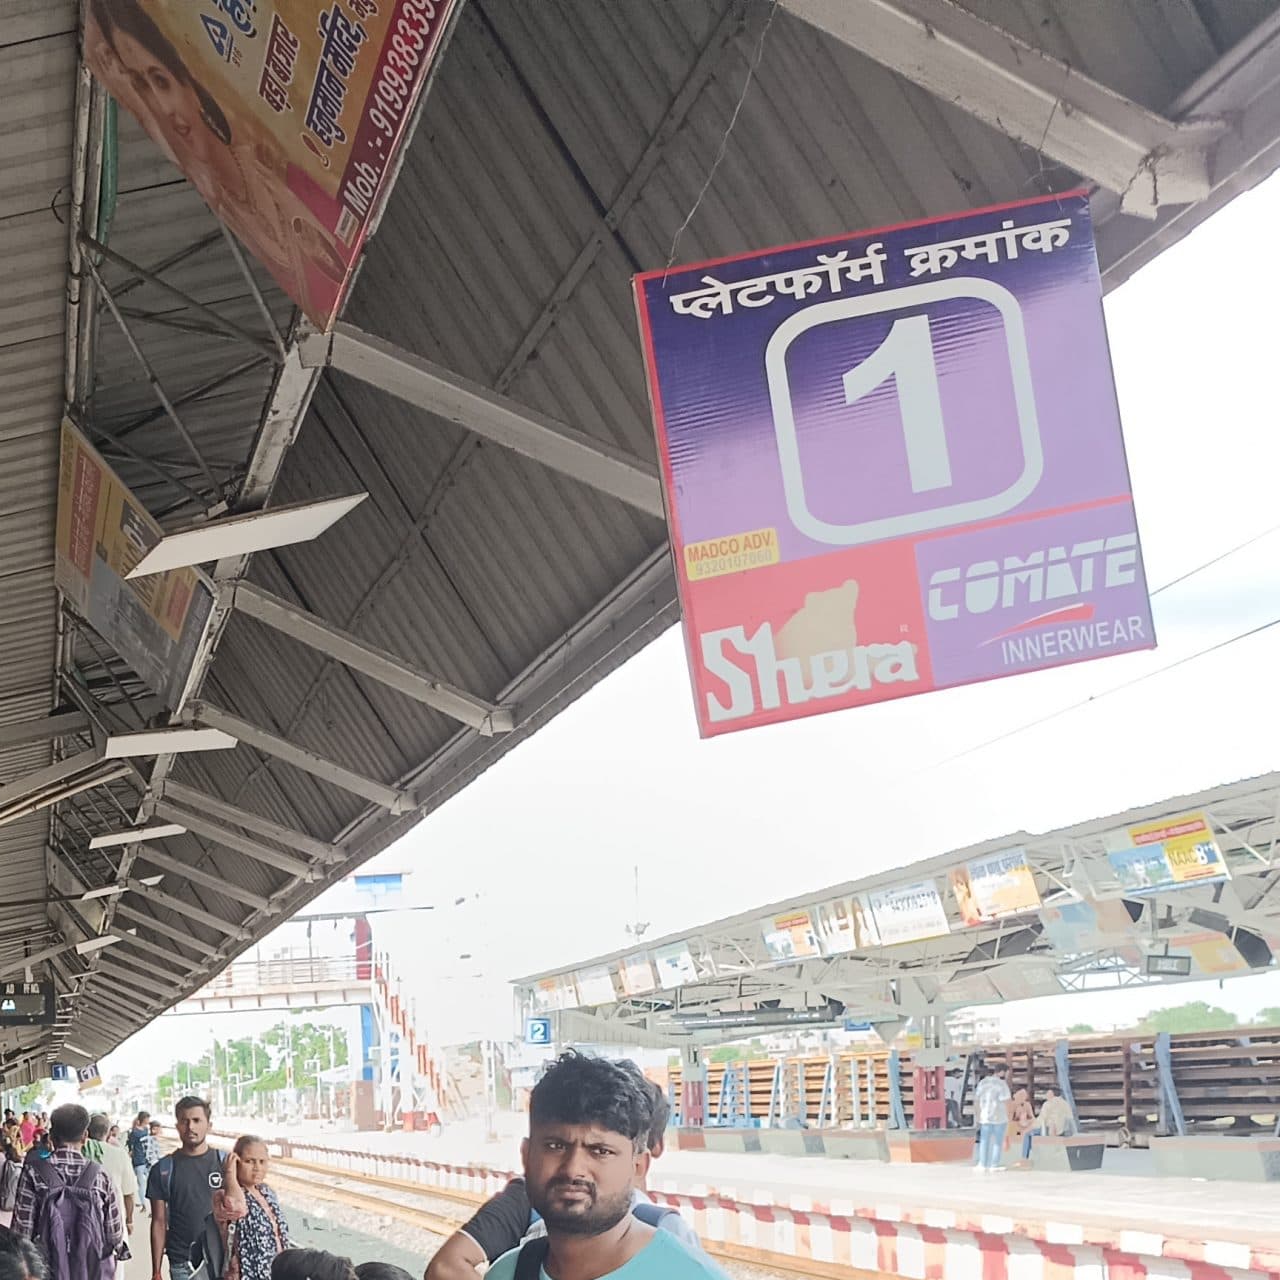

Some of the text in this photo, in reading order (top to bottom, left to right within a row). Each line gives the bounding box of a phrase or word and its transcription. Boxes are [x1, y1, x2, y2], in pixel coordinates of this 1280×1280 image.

[258, 12, 299, 112] बड़ा बाजार
[305, 57, 347, 148] हनुमान
[669, 218, 1072, 320] प्लेटफॉर्म क्रमांक
[841, 313, 953, 494] 1
[687, 538, 740, 562] MADCO
[928, 532, 1137, 621] COMATE
[700, 621, 920, 722] Shera
[1001, 615, 1145, 665] INNERWEAR
[531, 1023, 545, 1040] 2
